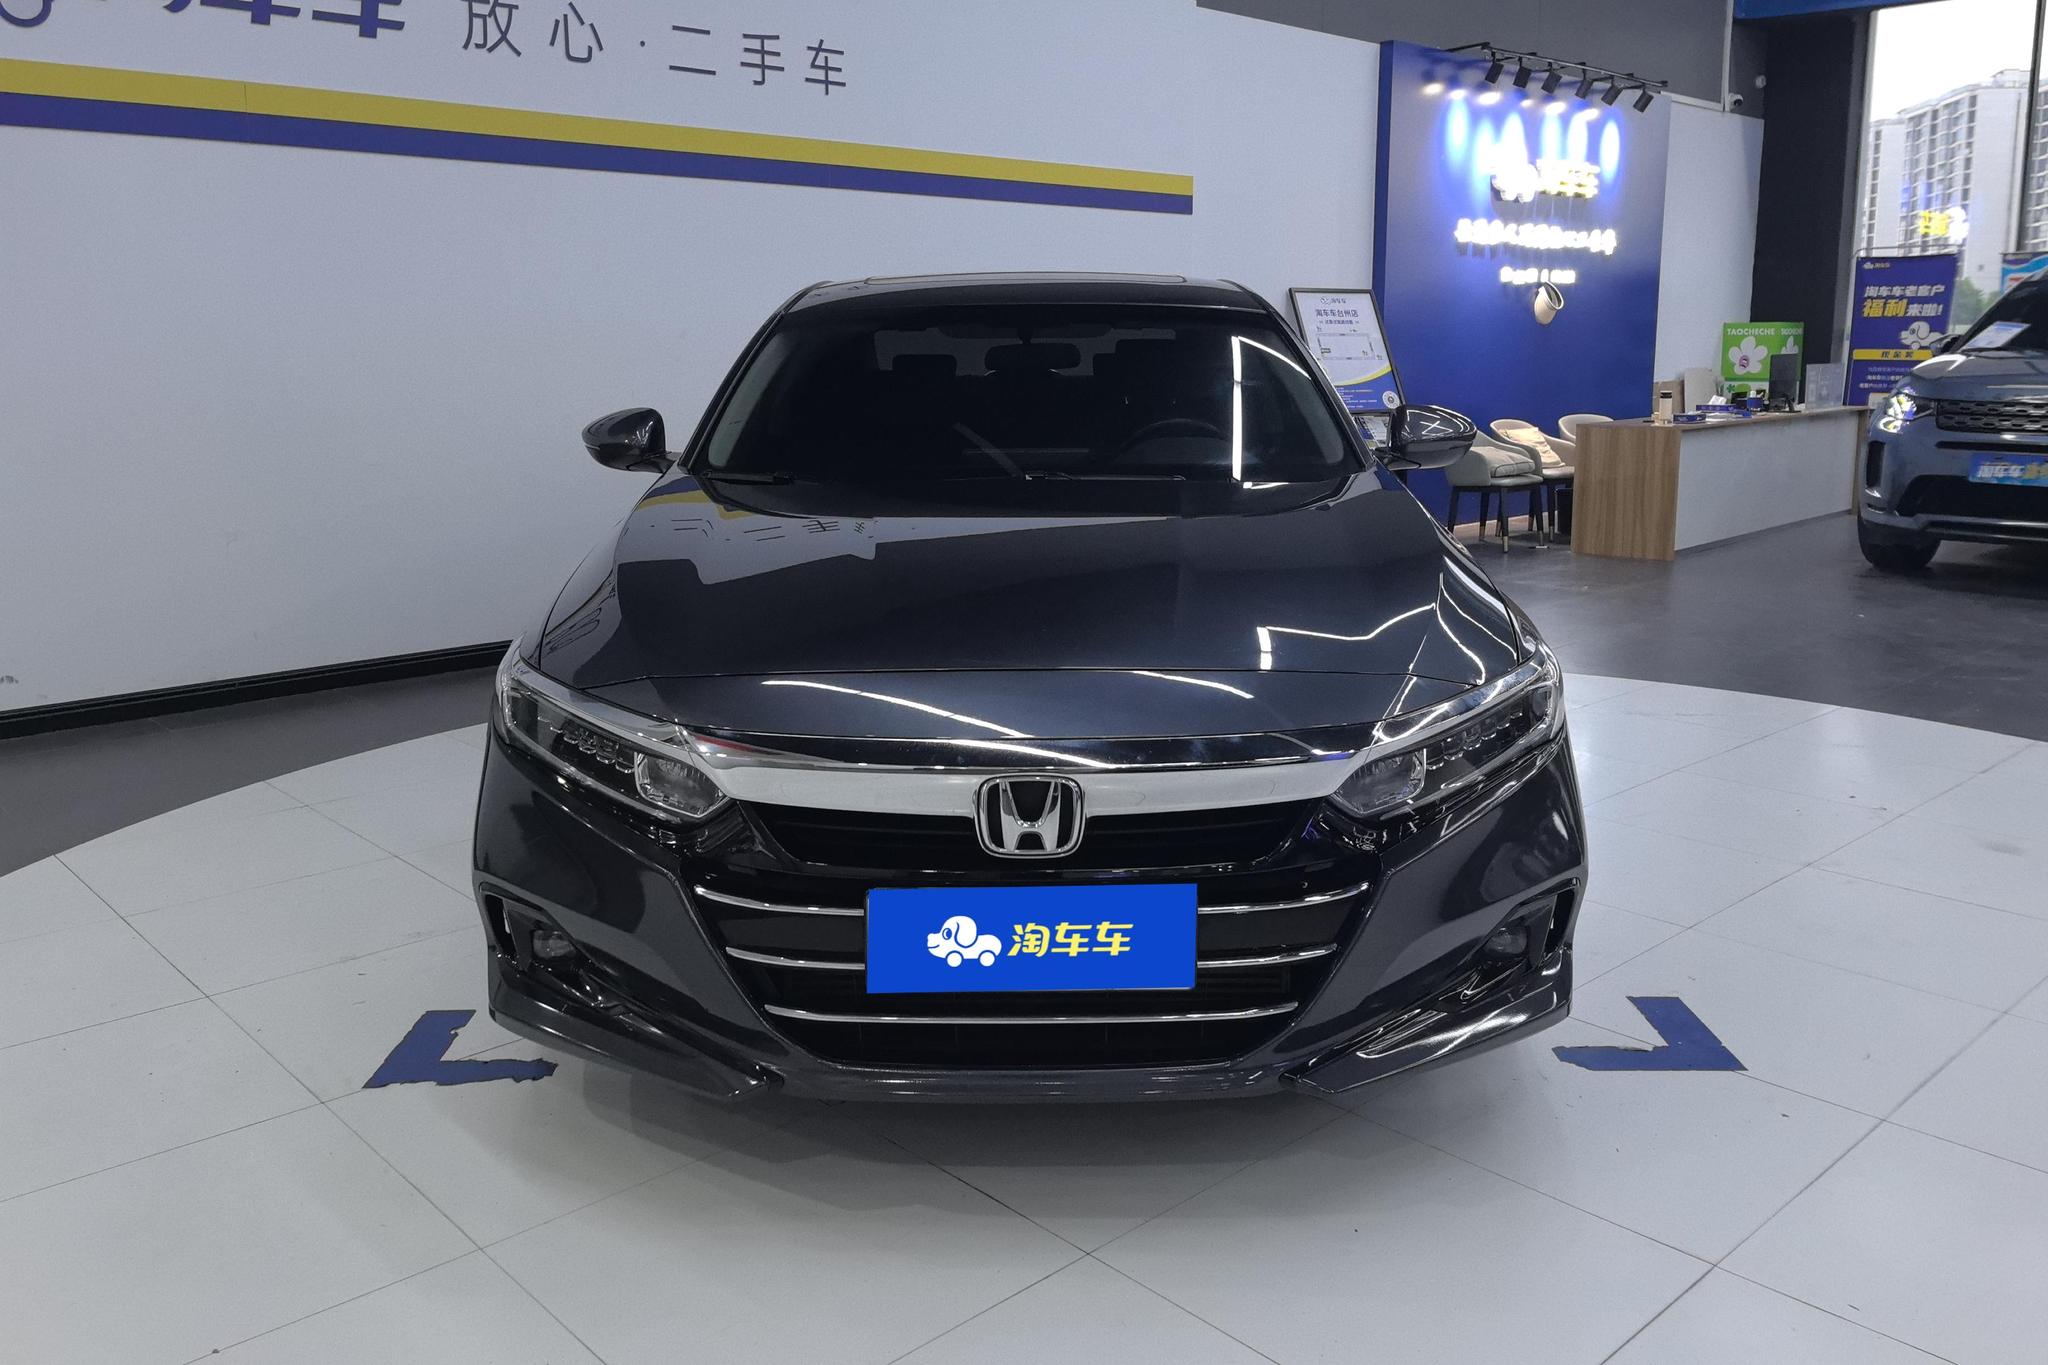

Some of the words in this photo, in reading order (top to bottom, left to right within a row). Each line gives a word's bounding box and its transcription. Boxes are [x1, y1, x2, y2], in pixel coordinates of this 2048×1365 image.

[1864, 285, 1946, 298] 淘车车老客户
[1727, 328, 1776, 336] TAOCHECHE
[1007, 922, 1134, 957] 淘车车
